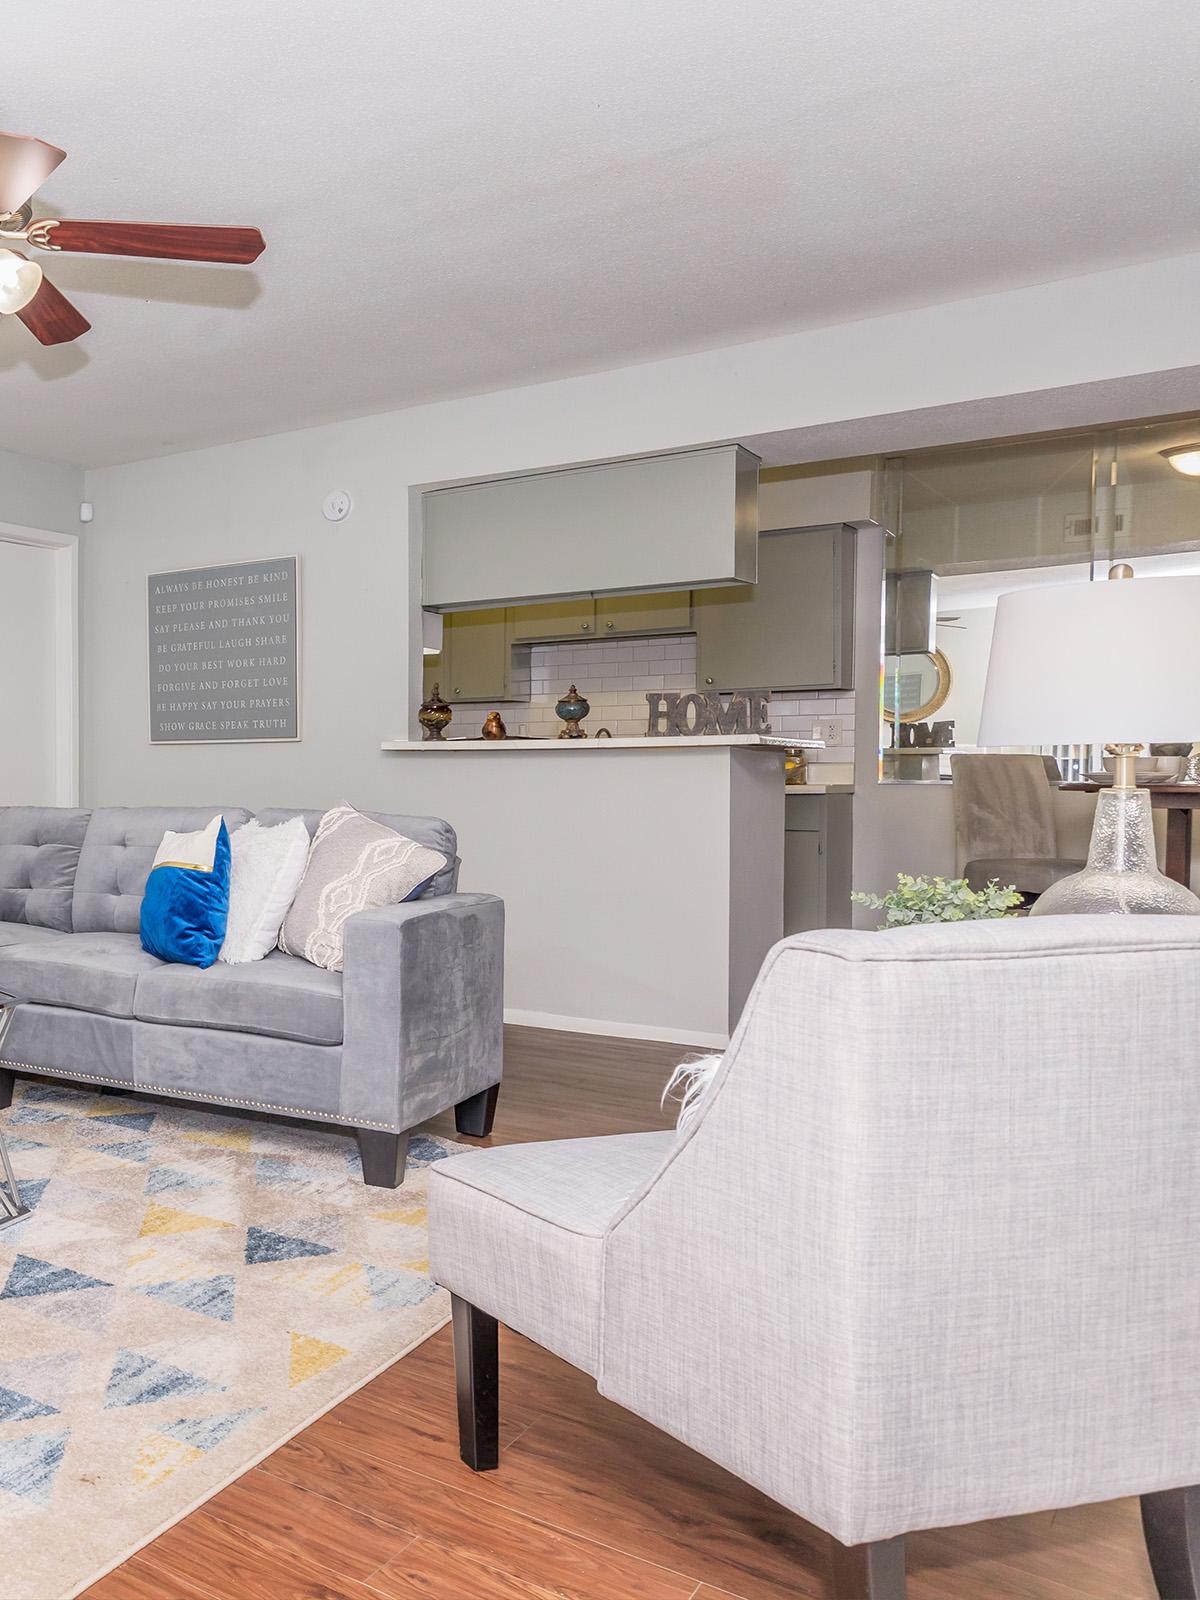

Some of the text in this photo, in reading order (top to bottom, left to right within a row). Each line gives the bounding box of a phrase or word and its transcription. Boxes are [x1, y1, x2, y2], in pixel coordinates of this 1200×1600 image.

[155, 572, 288, 594] ALWAYS BE HONEST BE KIND
[155, 593, 288, 614] KEEP YOUR PROMISES SMILE
[155, 614, 289, 633] SAY PLEASE AND THANK YOU
[157, 635, 287, 653] BE GRATEFUL LAUGH SHARE
[159, 657, 286, 672] DO YOUR BEST WORK HARD
[157, 677, 288, 692] FORGIVE AND FORGET LOVE
[157, 698, 290, 712] BE HAPPY SAY YOUR PRAYERS
[645, 691, 771, 737] HOME
[160, 719, 287, 731] SHOW GRACE SPEAK TRUTH
